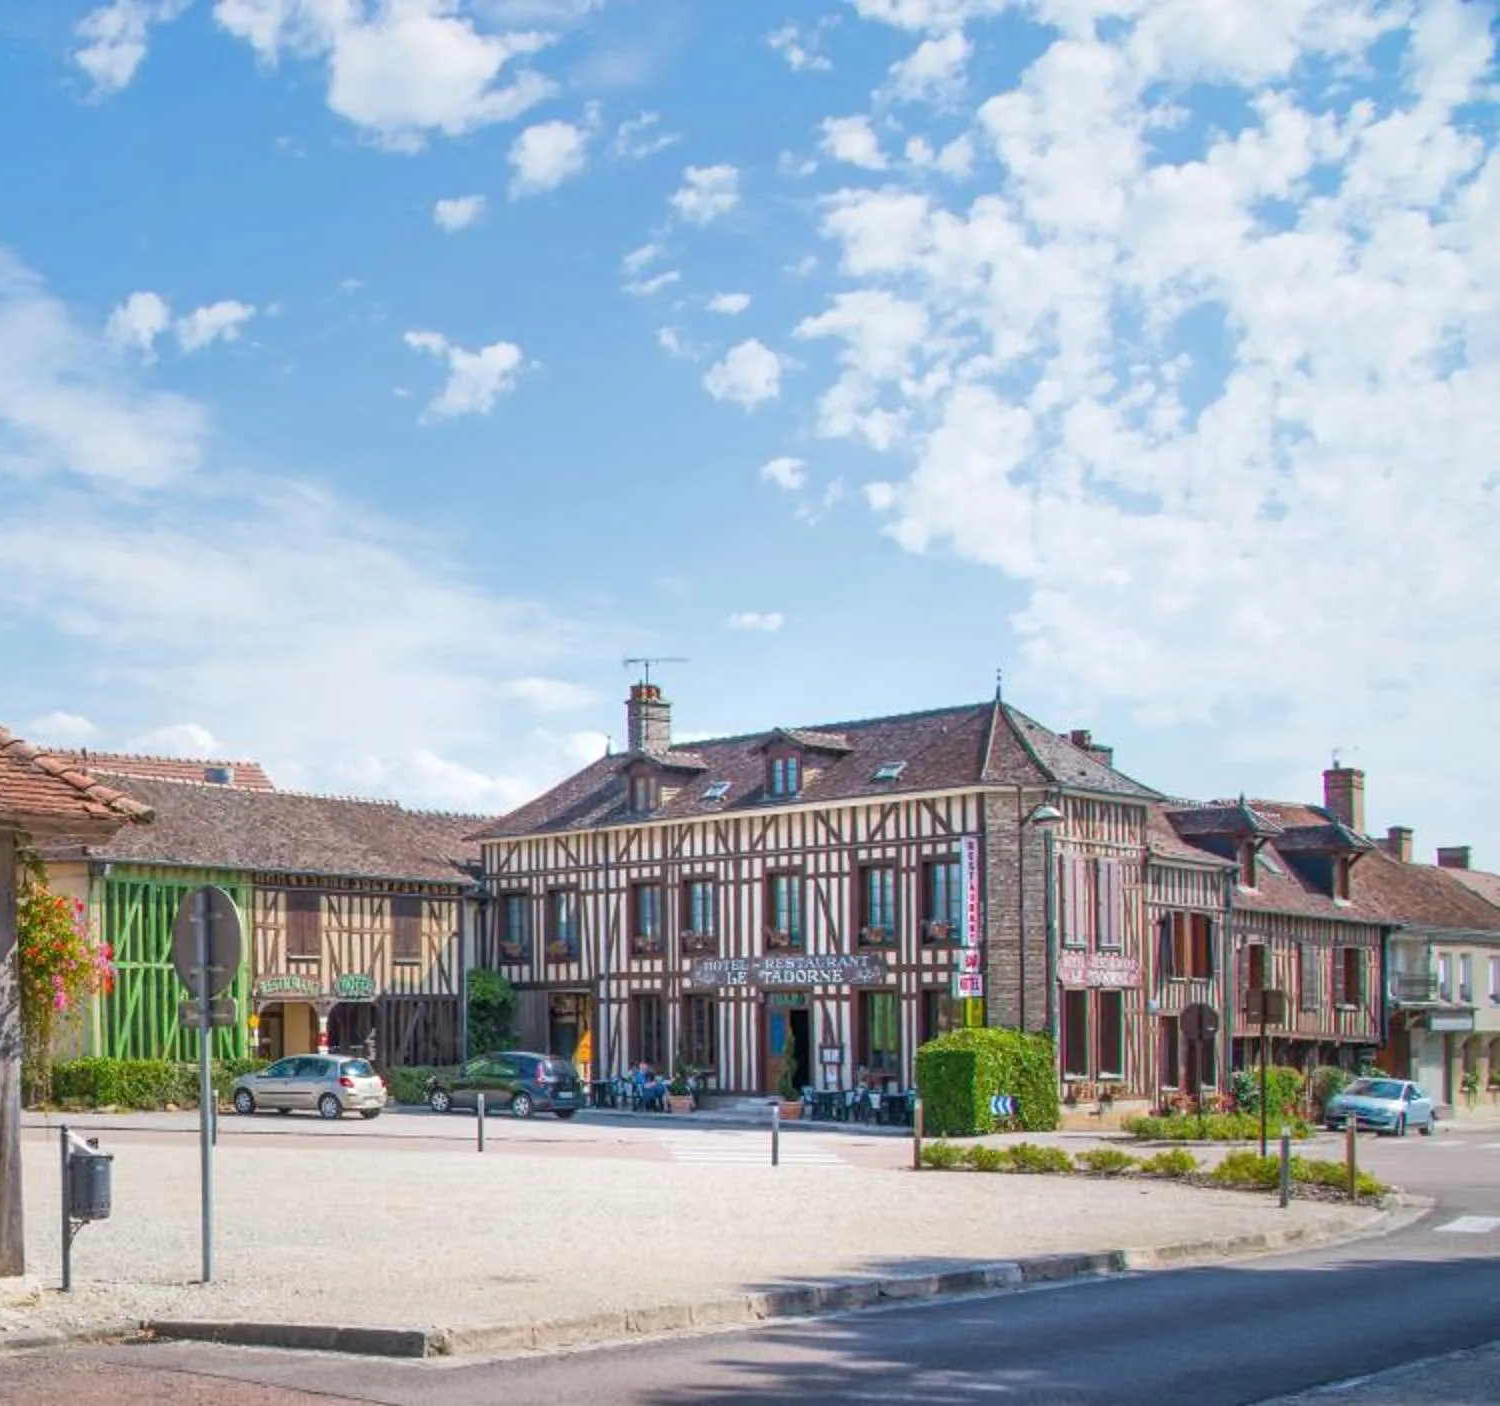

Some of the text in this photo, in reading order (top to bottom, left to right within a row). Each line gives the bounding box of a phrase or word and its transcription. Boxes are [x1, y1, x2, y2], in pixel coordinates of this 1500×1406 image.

[764, 956, 869, 969] RESTAURANT
[727, 970, 843, 985] LE TADORNE
